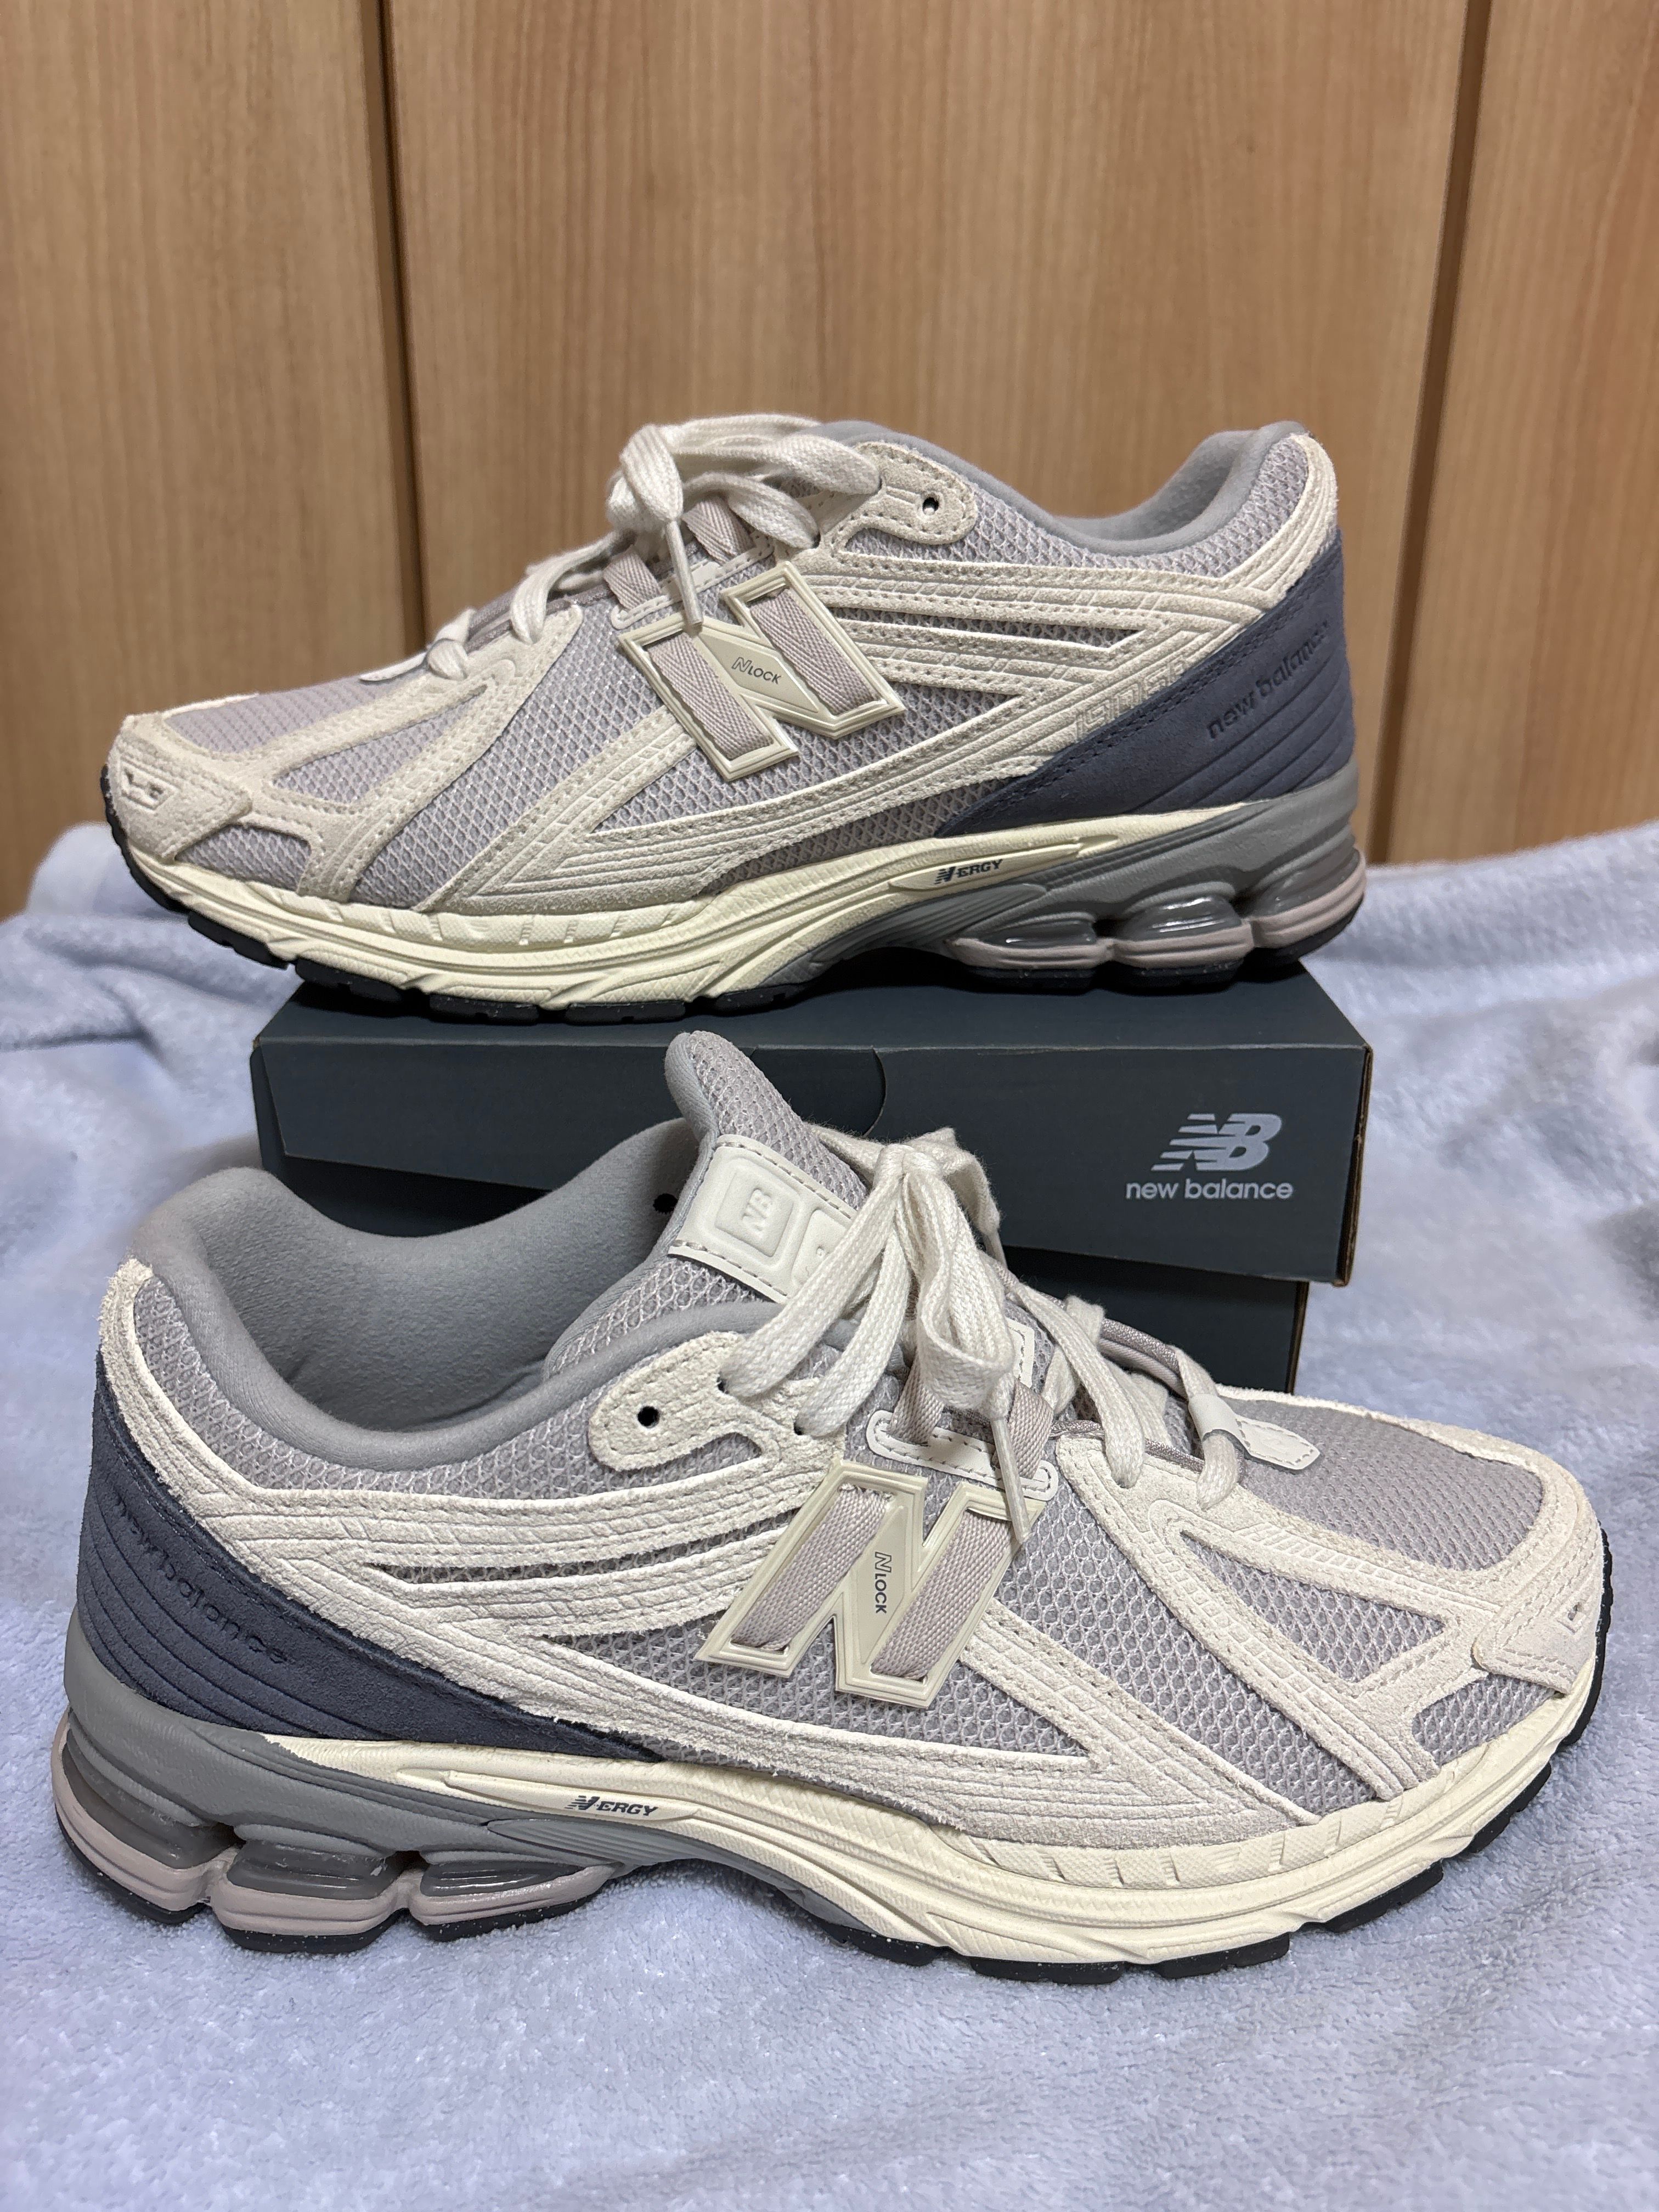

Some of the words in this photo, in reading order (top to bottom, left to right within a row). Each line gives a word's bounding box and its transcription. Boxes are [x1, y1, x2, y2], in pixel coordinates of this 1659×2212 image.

[1208, 690, 1255, 740] new
[1125, 1182, 1179, 1199] new
[1184, 1178, 1294, 1199] balance
